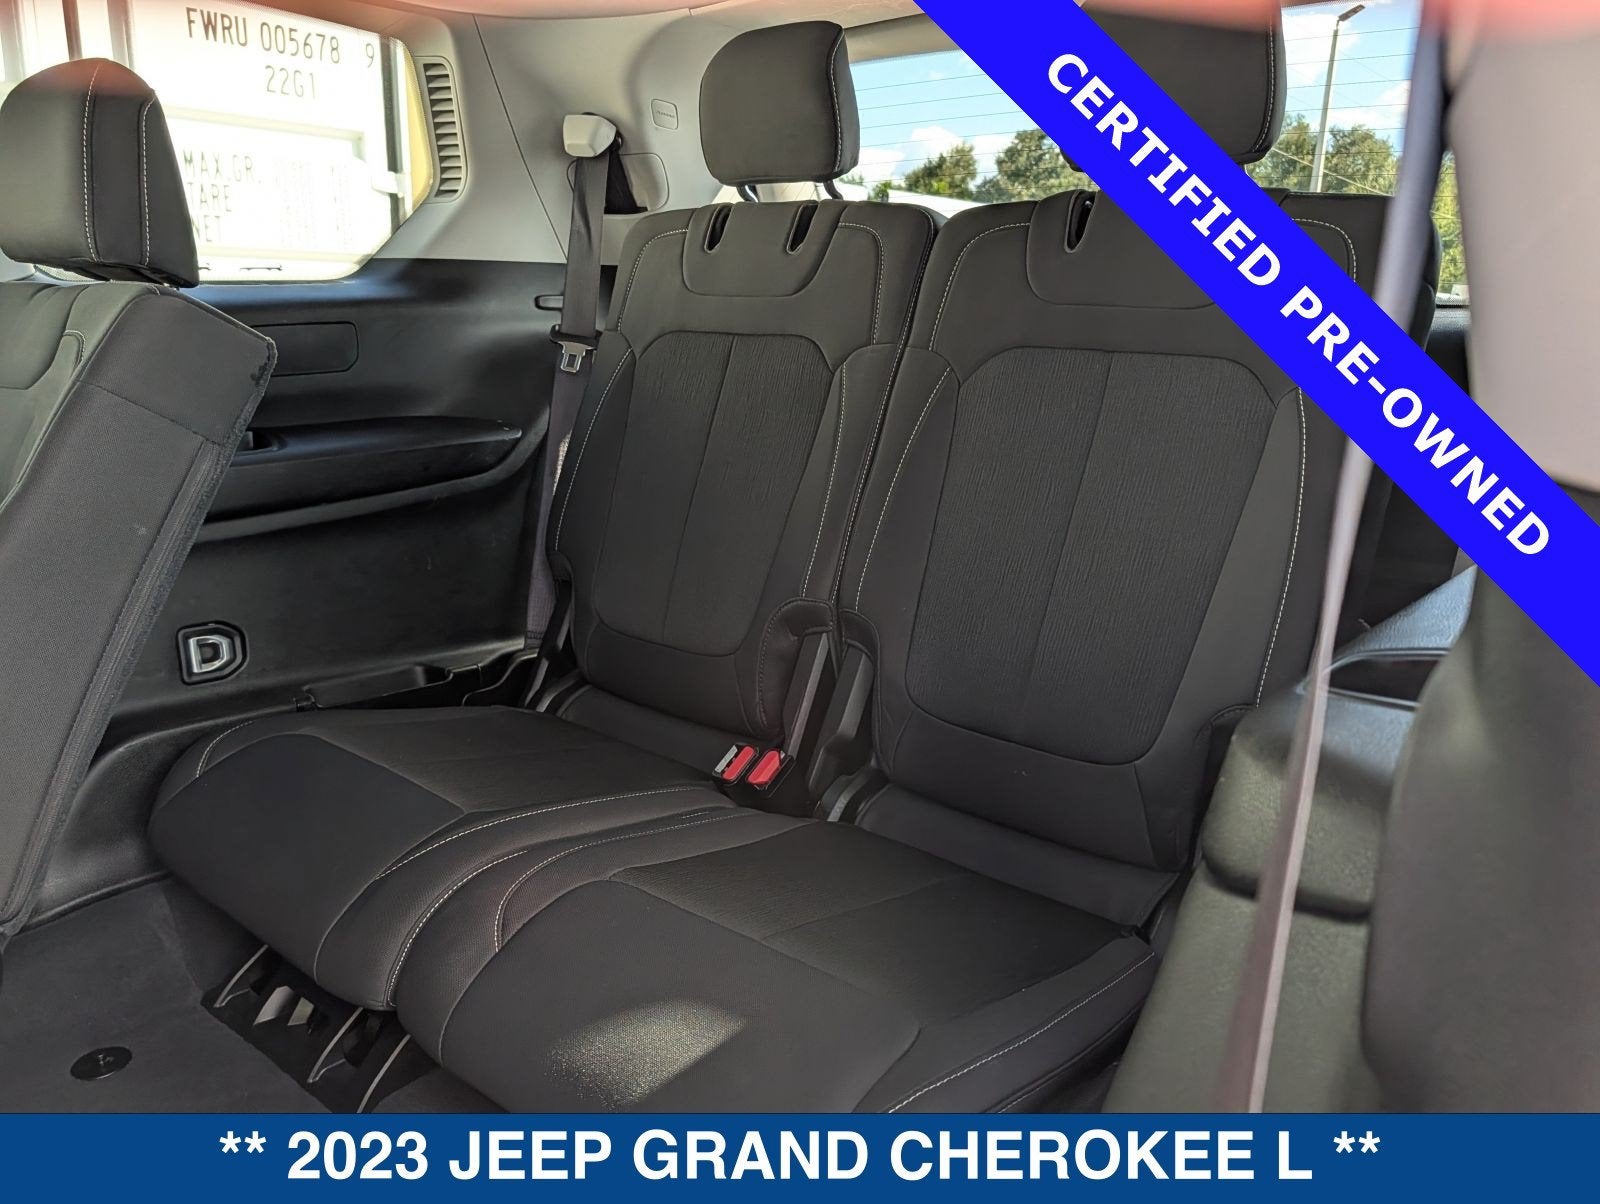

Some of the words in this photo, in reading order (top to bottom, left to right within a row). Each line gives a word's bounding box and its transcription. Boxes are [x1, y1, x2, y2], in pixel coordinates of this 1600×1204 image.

[185, 6, 248, 47] FWRU
[259, 21, 341, 64] 005678
[365, 42, 375, 68] 9
[264, 64, 316, 99] 22G1
[187, 181, 233, 213] TARE
